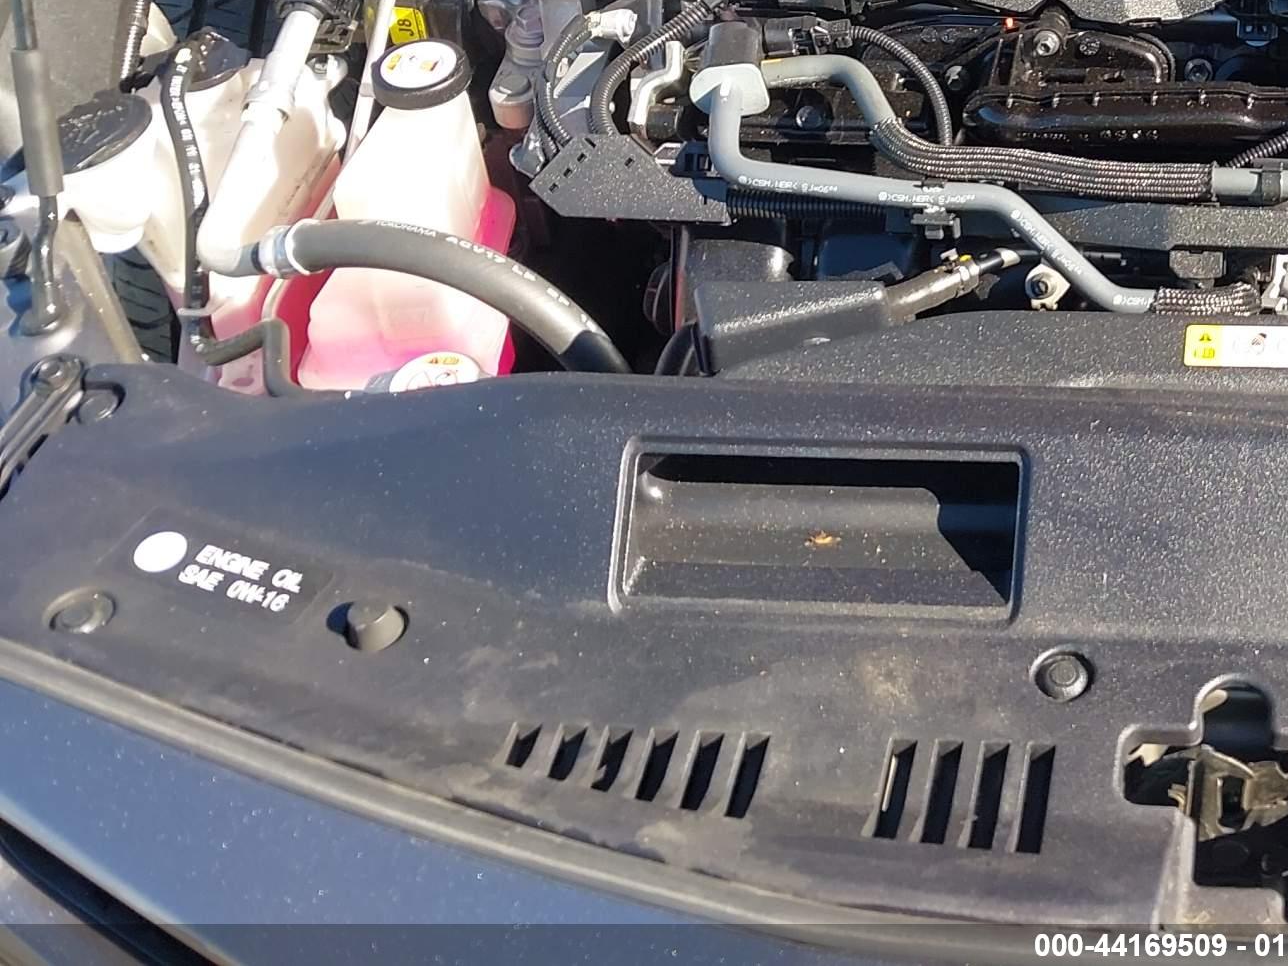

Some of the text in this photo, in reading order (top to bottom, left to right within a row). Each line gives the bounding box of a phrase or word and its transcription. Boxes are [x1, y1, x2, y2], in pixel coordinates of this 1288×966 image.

[396, 18, 415, 37] J8
[178, 564, 290, 612] SAE 0W-16
[195, 544, 303, 594] ENGINE OIL
